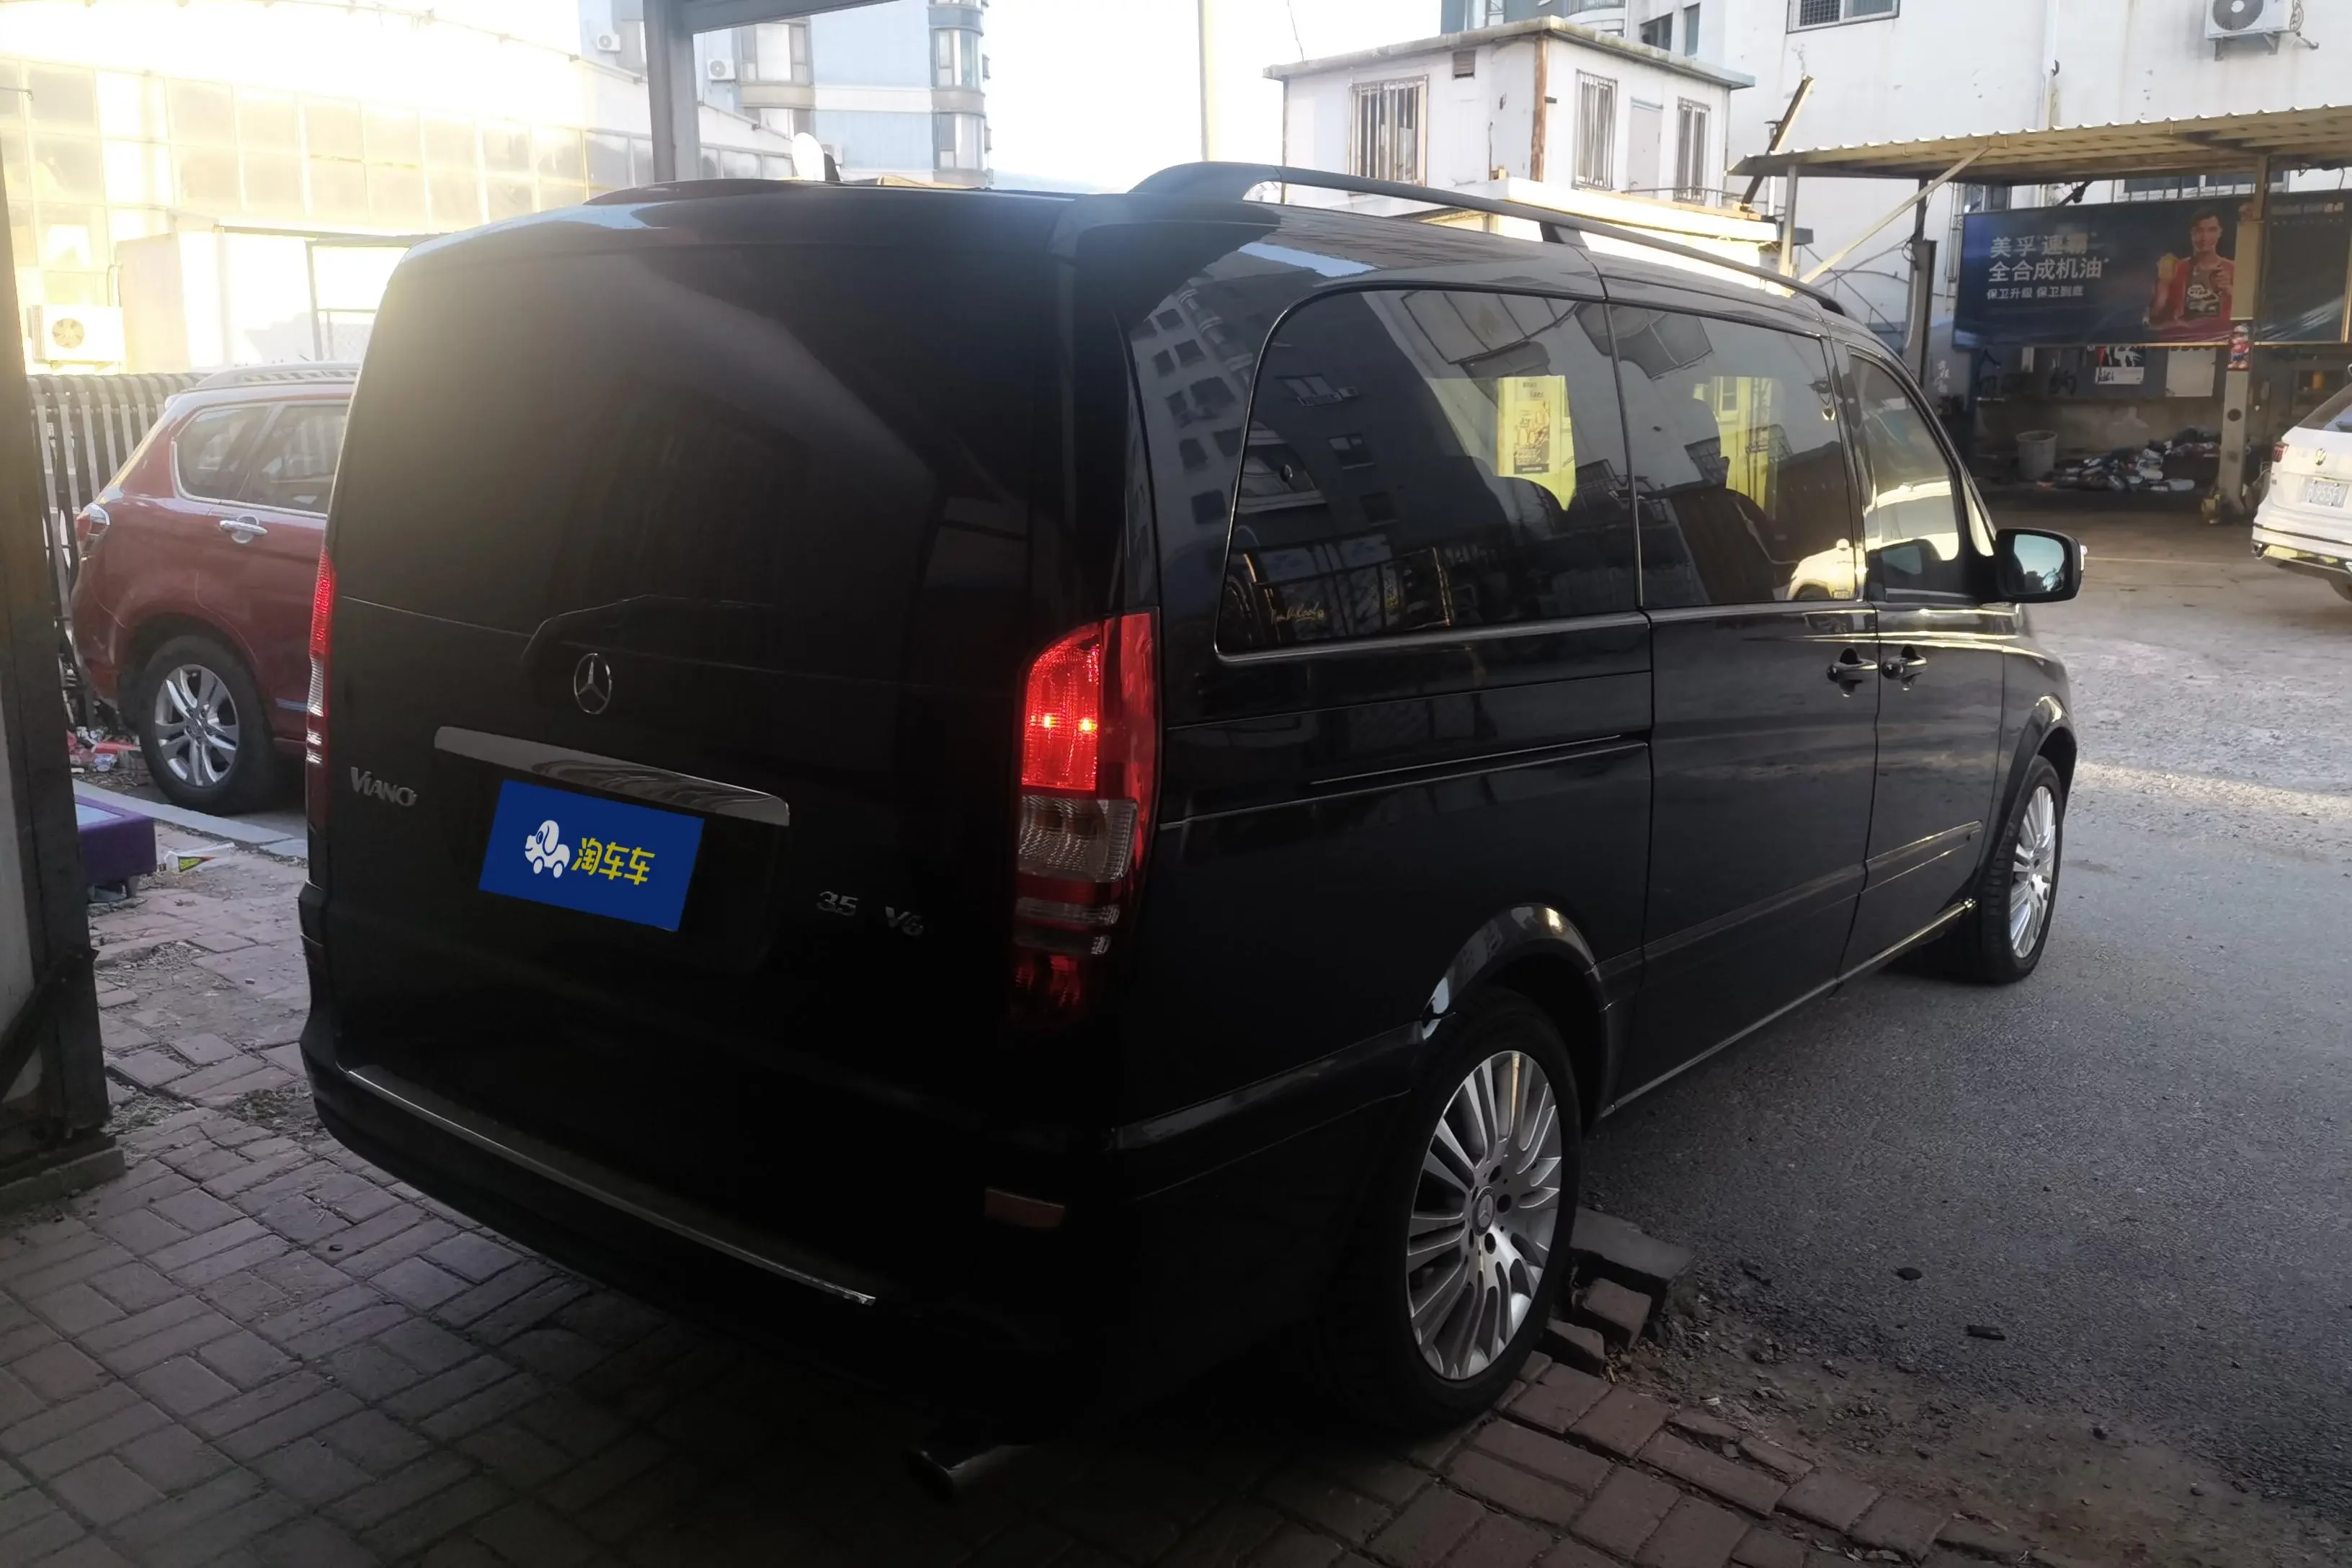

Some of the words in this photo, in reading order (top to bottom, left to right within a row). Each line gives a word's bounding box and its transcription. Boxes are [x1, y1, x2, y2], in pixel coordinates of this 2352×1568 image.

[1989, 257, 2103, 282] 全合成机油
[350, 766, 417, 806] VIANO
[885, 905, 925, 935] V6
